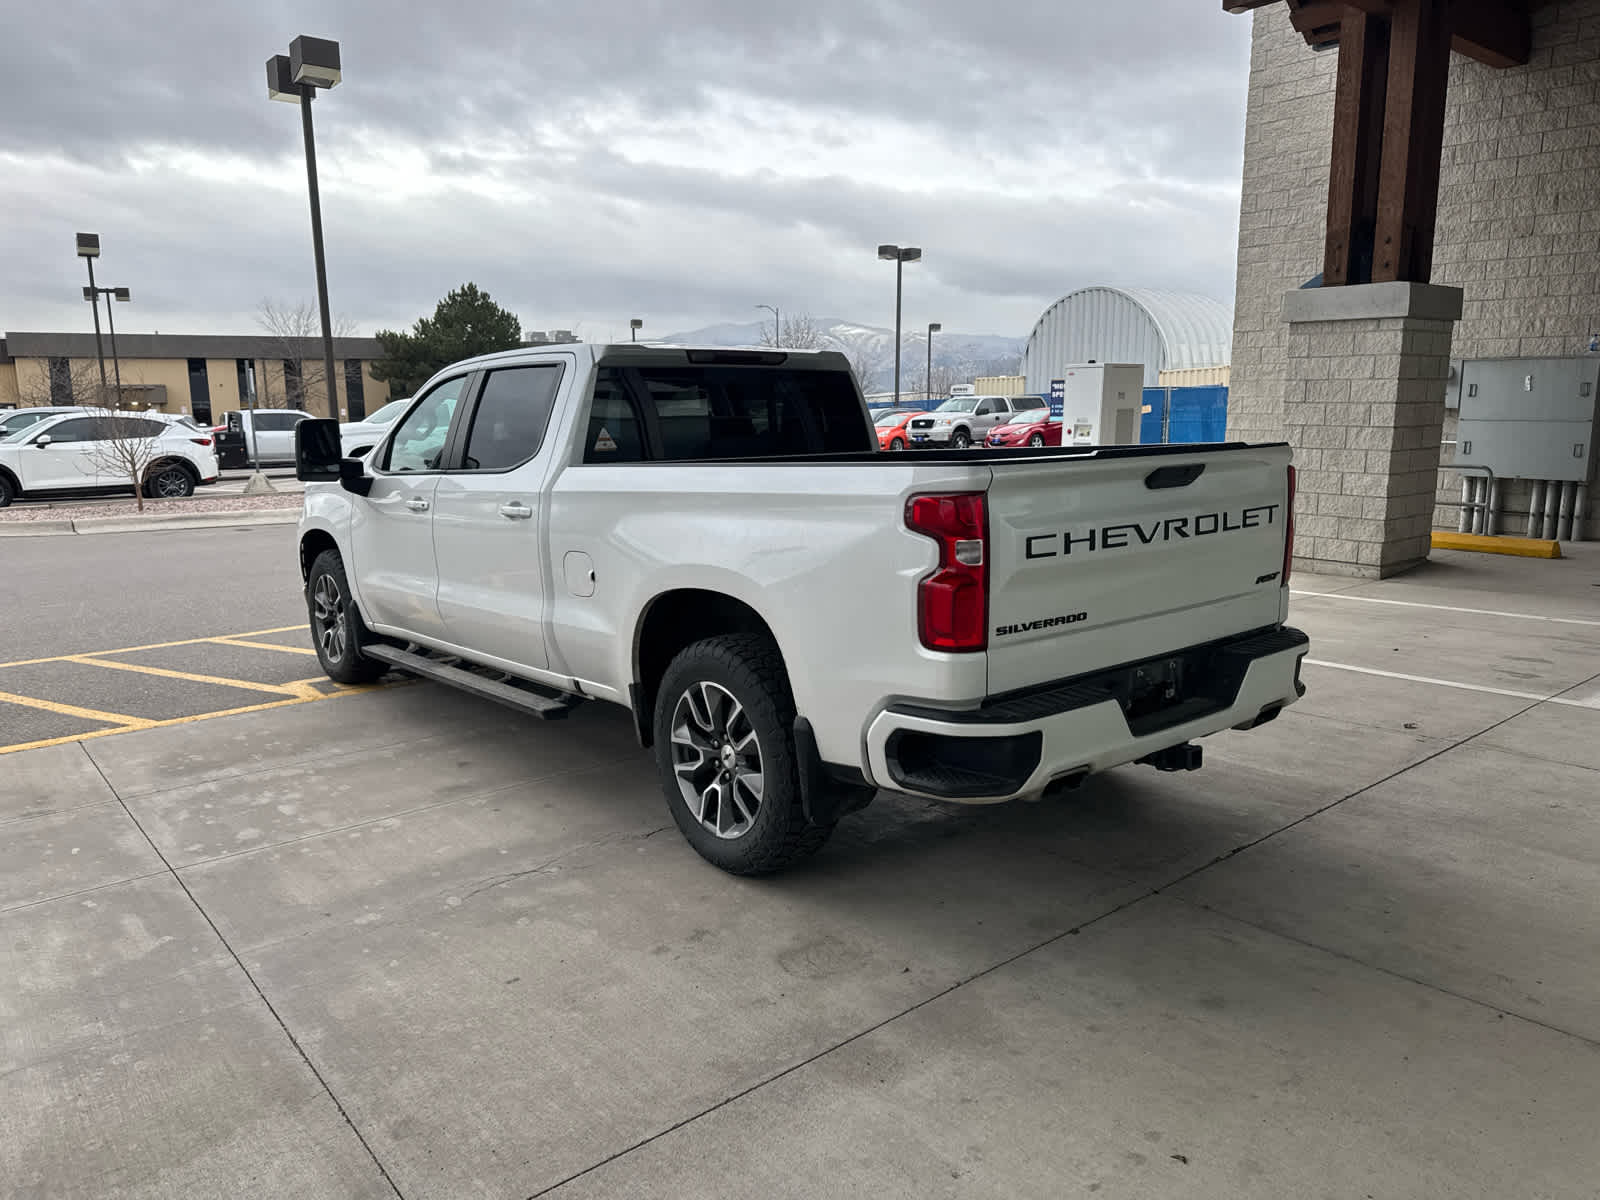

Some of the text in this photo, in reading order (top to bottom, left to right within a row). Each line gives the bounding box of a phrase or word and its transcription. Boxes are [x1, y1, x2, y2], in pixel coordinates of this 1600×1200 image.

[1026, 504, 1279, 559] CHEVROLET
[1255, 571, 1280, 584] RST
[995, 611, 1087, 636] SILVERADO
